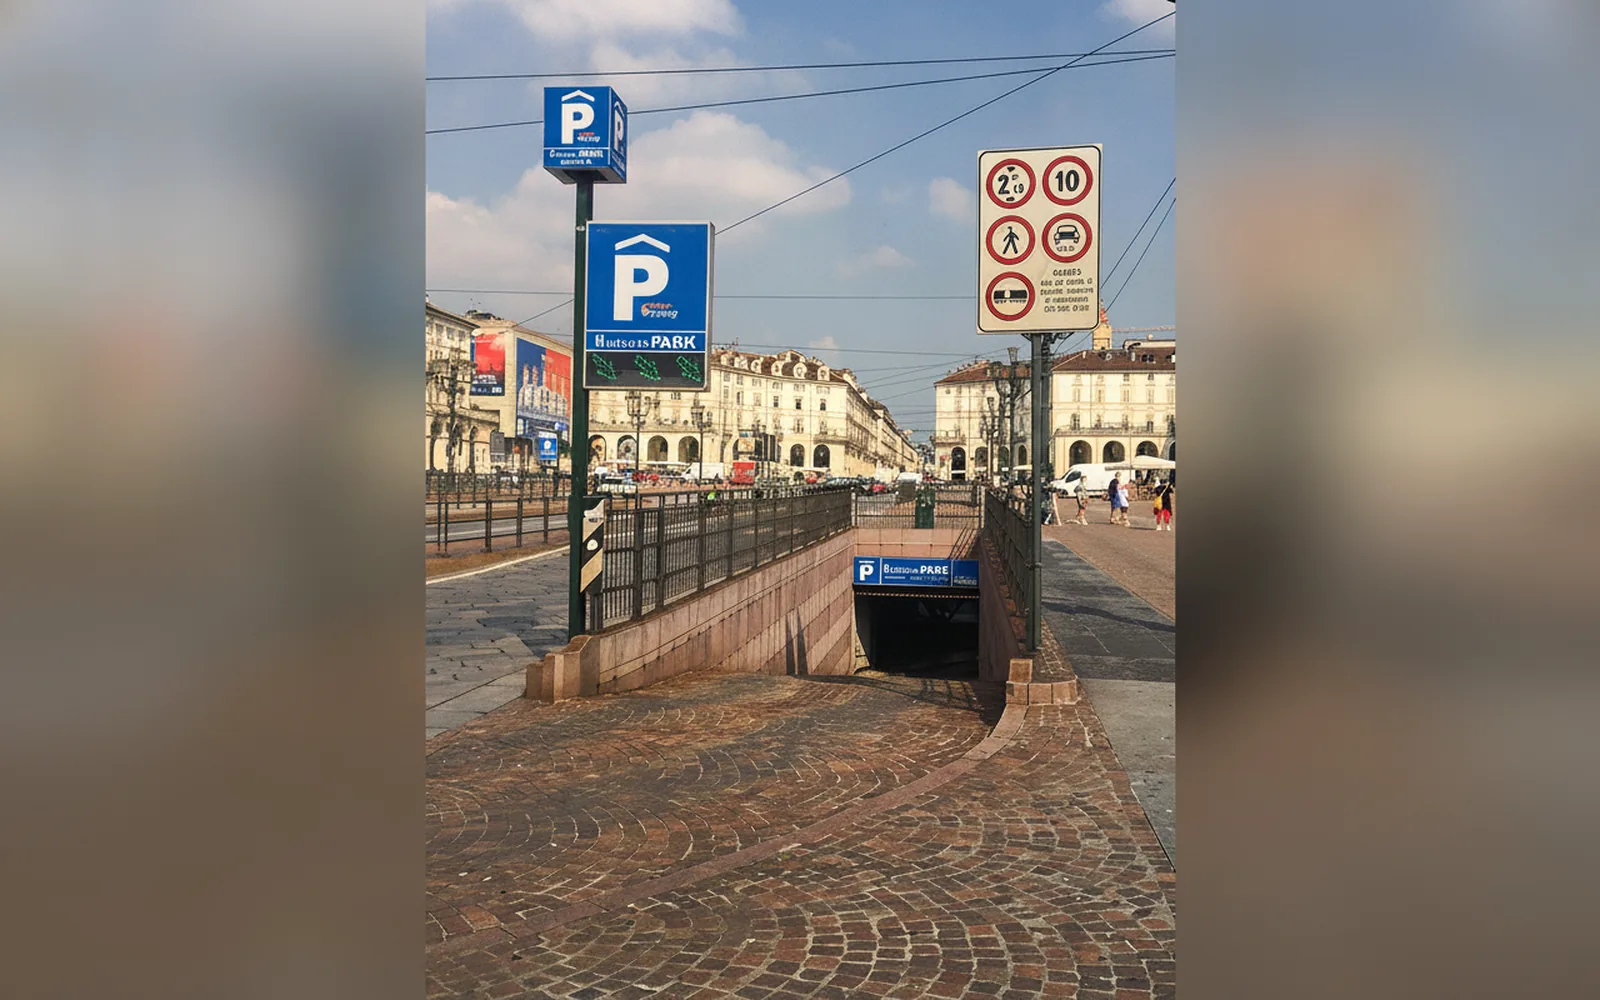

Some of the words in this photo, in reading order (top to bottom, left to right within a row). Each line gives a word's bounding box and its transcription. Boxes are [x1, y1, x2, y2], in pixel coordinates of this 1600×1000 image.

[561, 103, 595, 144] P
[613, 109, 624, 151] P
[1055, 169, 1080, 192] 10
[613, 254, 669, 321] P
[651, 335, 696, 349] PARK
[859, 564, 875, 581] P
